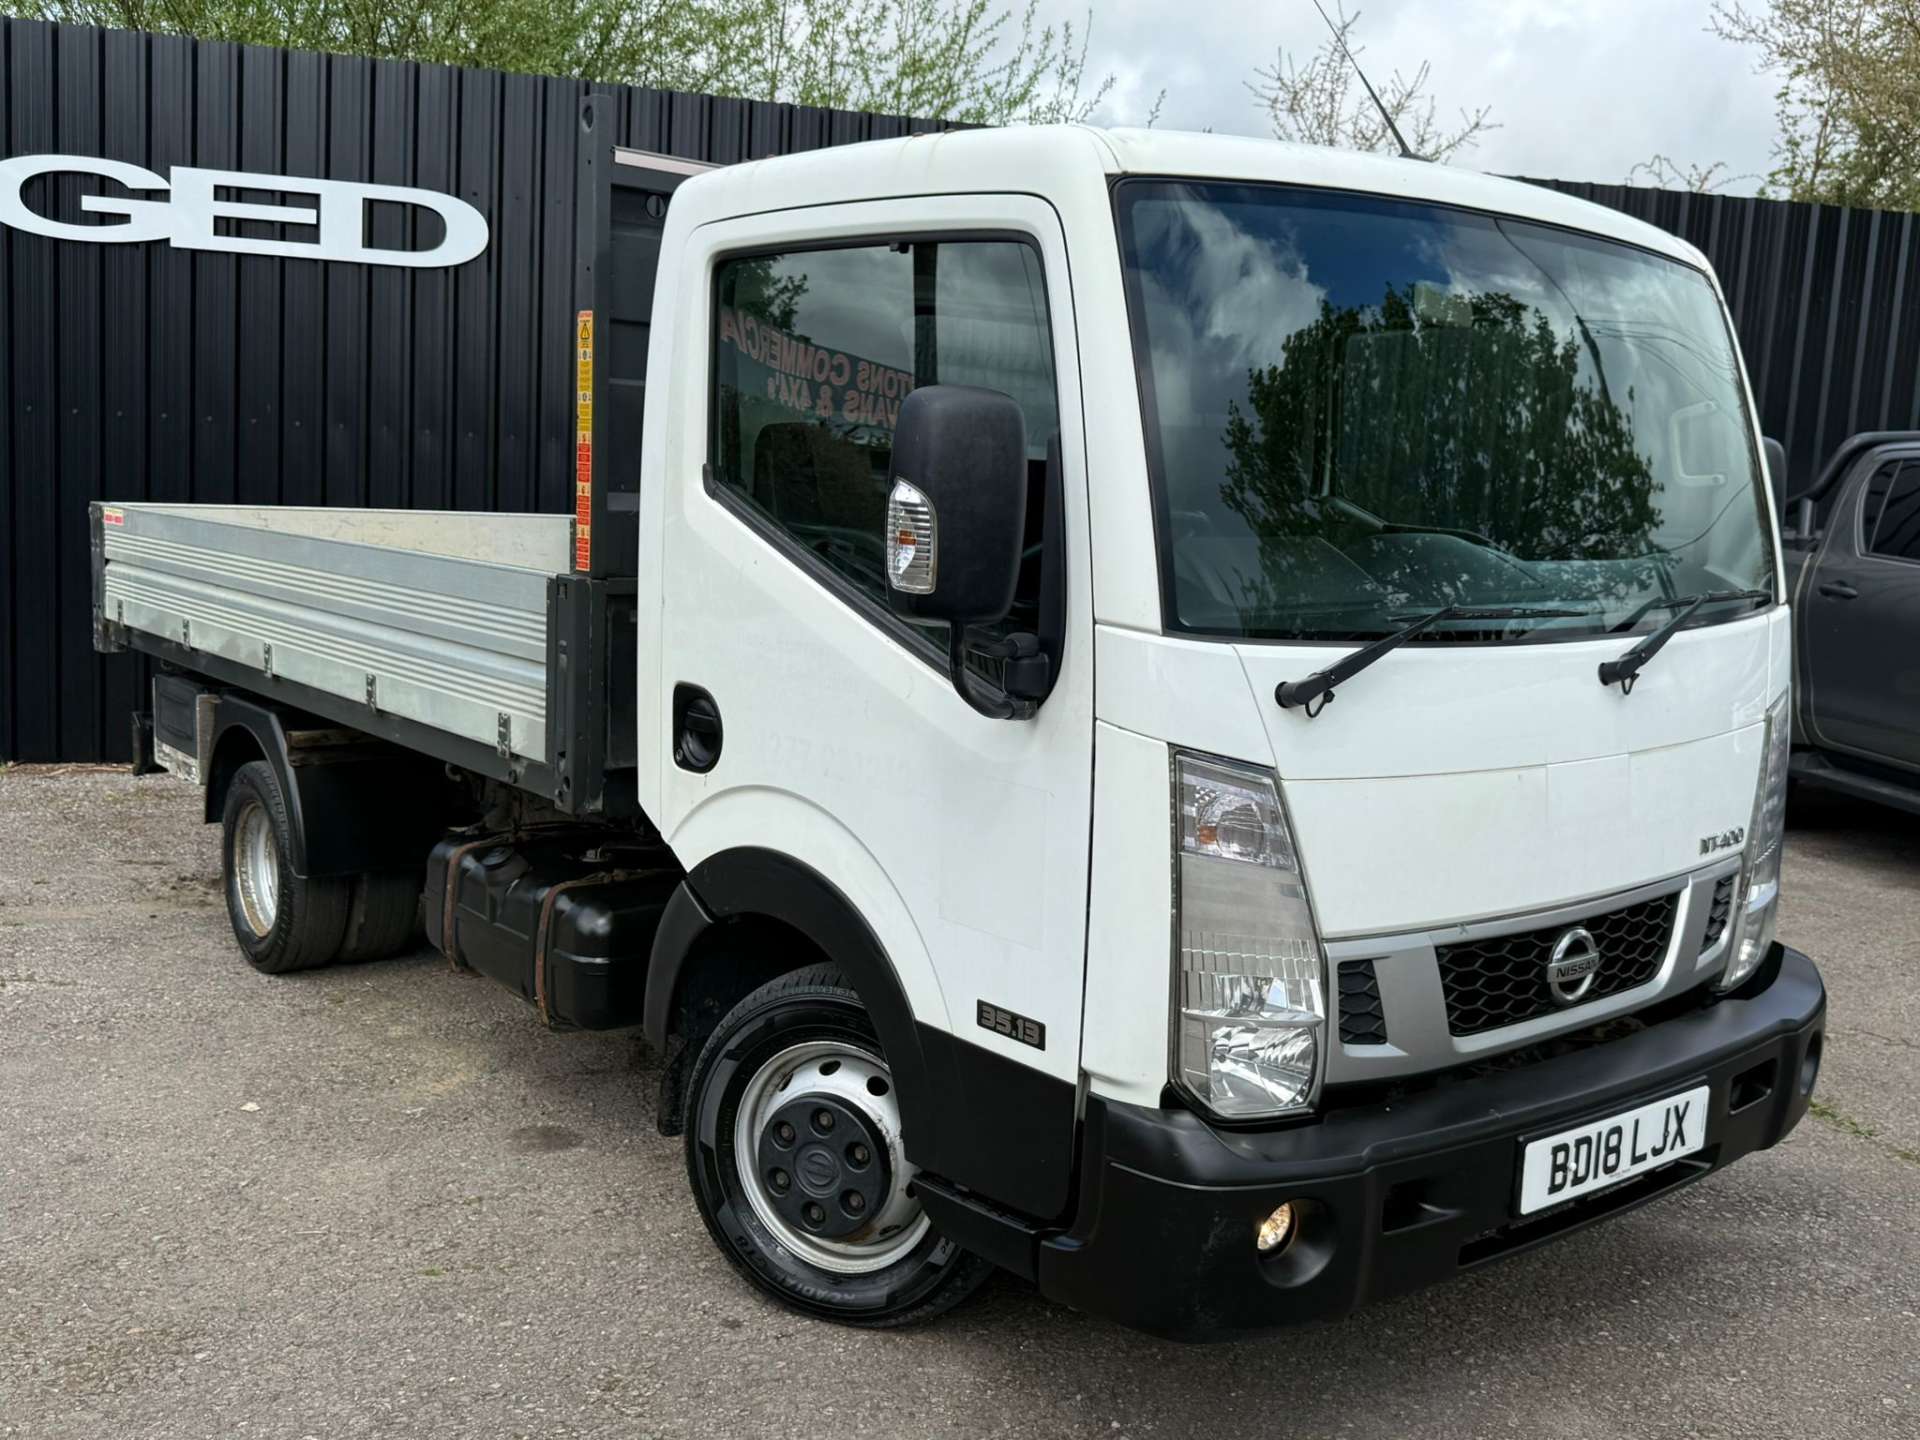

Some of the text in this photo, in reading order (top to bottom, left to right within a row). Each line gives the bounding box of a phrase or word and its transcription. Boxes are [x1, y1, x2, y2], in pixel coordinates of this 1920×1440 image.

[0, 154, 489, 267] GED
[1556, 959, 1596, 978] NISSAN
[981, 1005, 1040, 1045] 35.13
[1547, 1125, 1623, 1195] BD18
[1631, 1101, 1690, 1166] LJX
